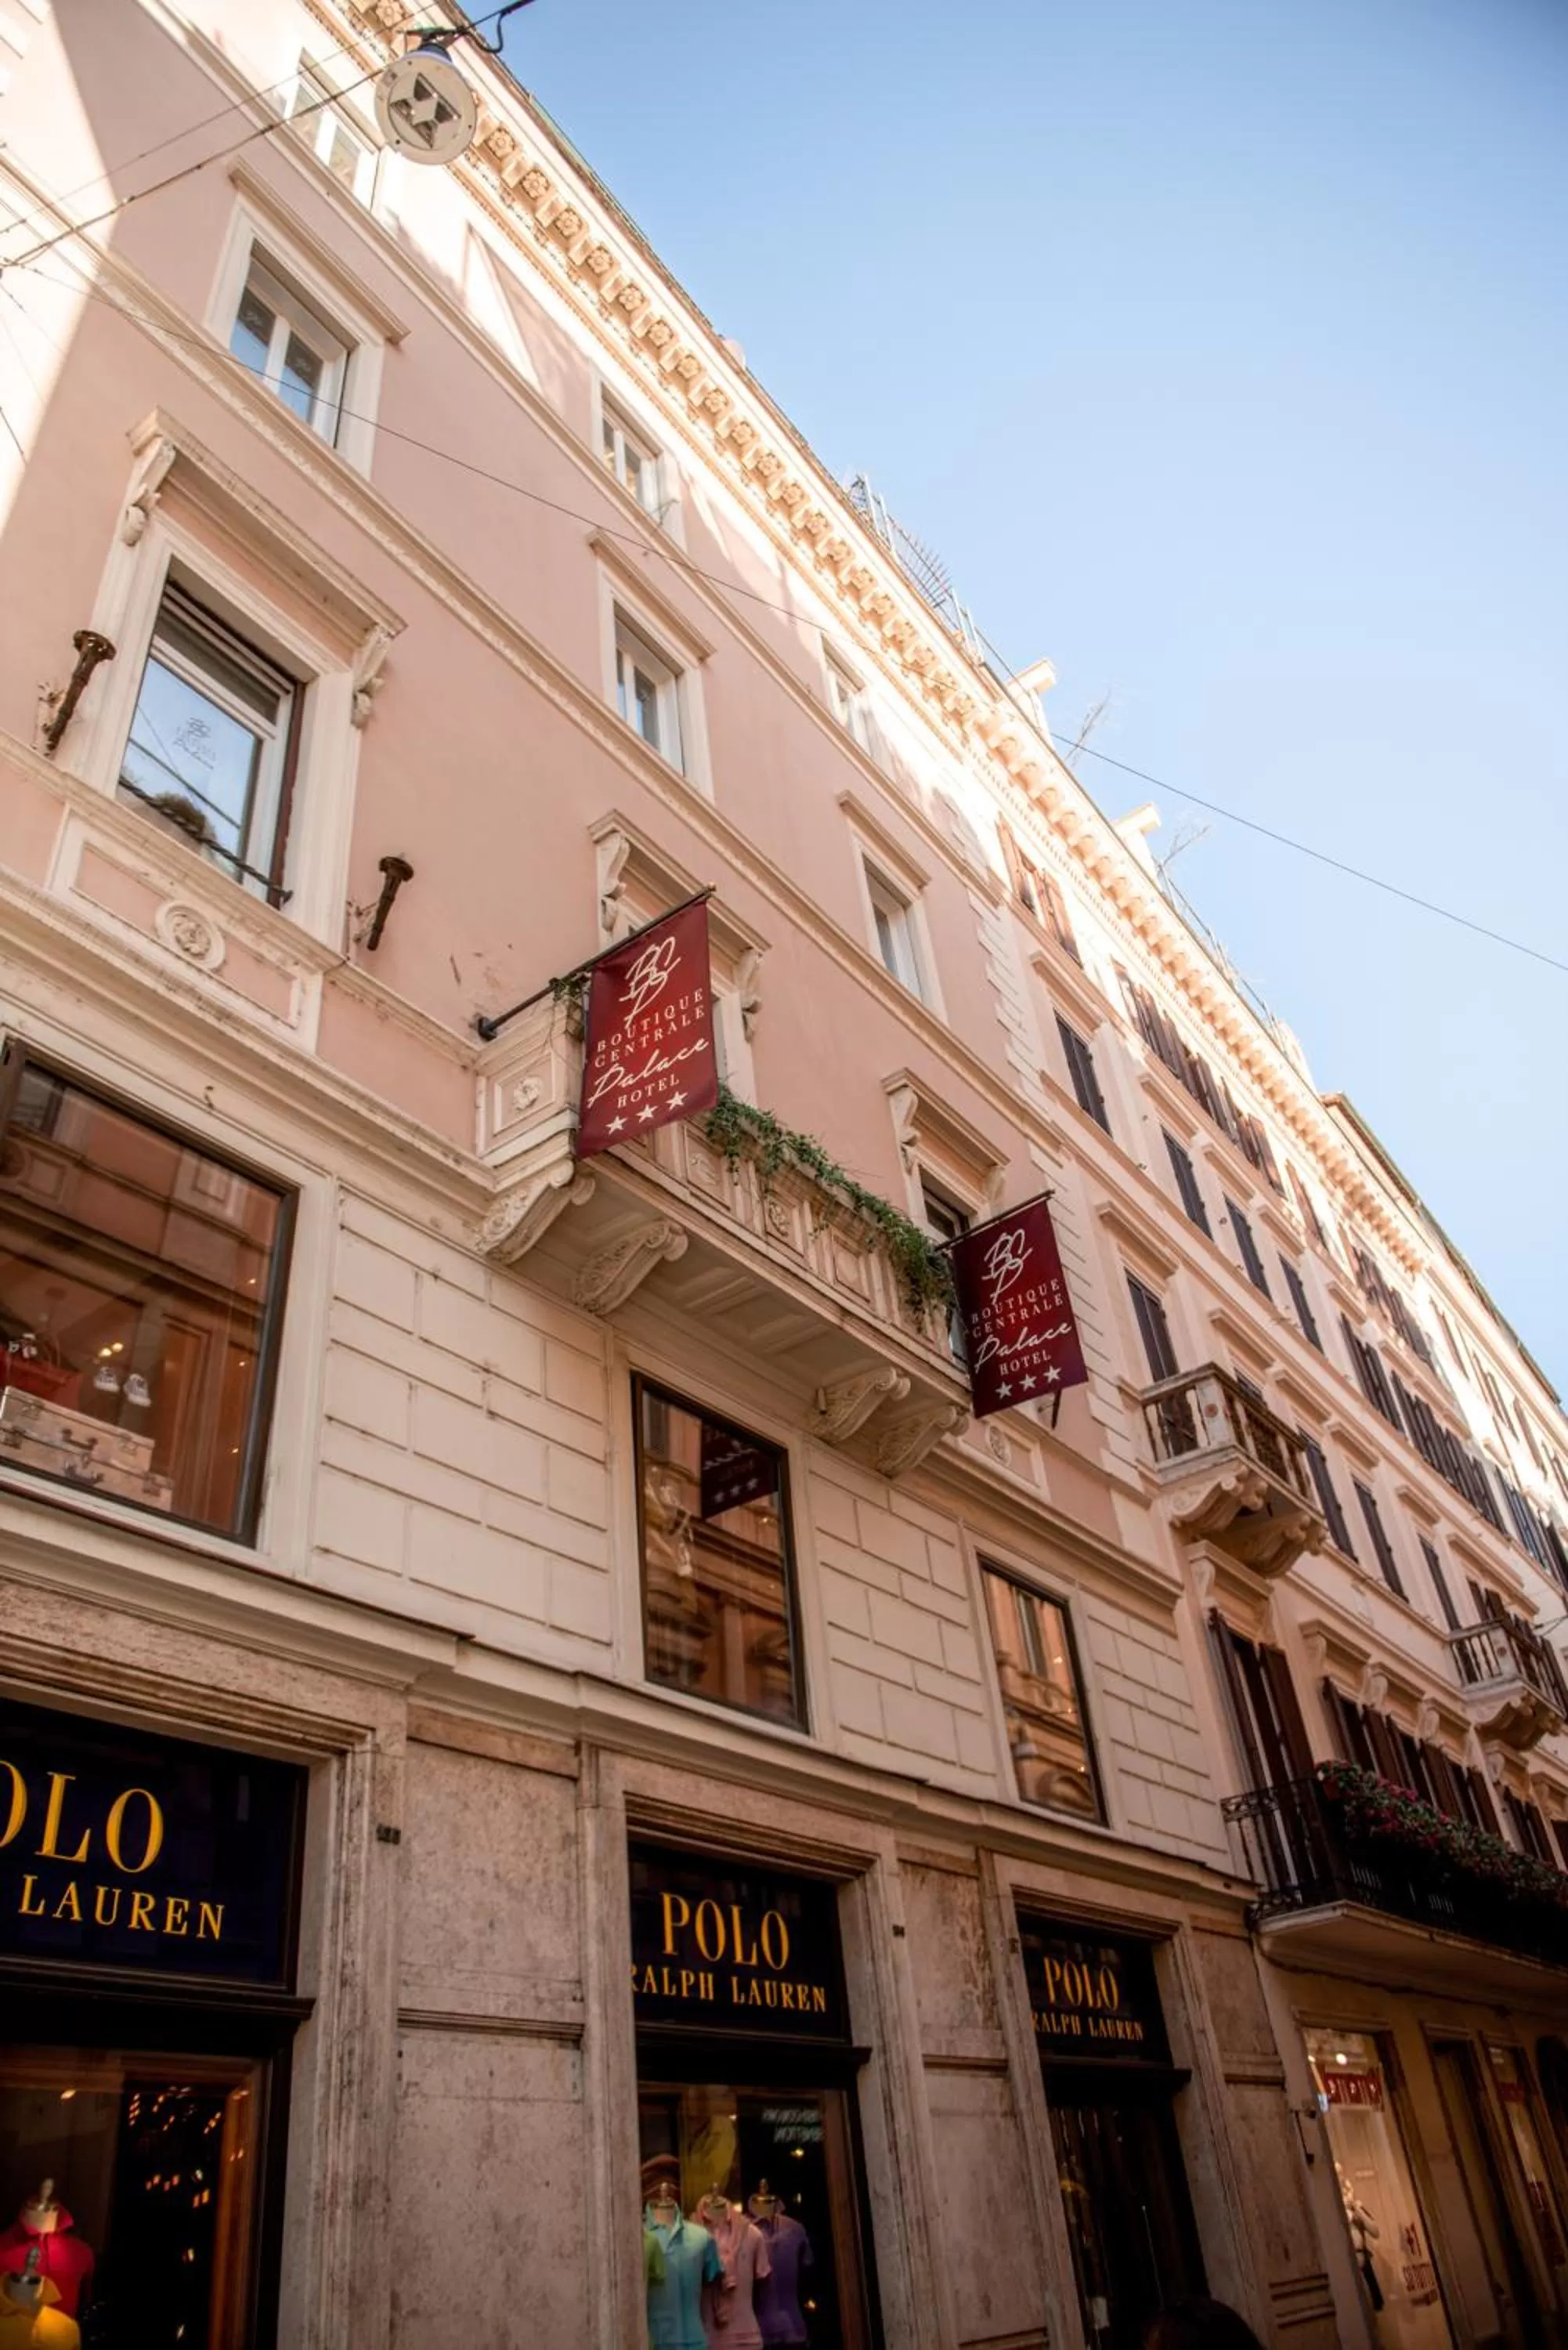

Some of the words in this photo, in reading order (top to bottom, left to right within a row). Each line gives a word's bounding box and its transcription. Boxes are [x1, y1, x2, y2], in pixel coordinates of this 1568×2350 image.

[594, 1004, 706, 1068] CENTRALE
[596, 987, 704, 1054] BOUTIQUE
[587, 1037, 710, 1108] Palace
[616, 1073, 681, 1109] HOTEL
[970, 1278, 1060, 1325] BOUTIQUE
[972, 1293, 1064, 1339] CENTRALE
[974, 1321, 1072, 1374] Palace
[998, 1349, 1052, 1376] HOTEL
[18, 1874, 226, 1941] LAUREN
[659, 1891, 790, 1971] POLO
[730, 1976, 827, 2013] LAUREN
[1043, 1956, 1119, 2010] POLO
[1088, 2016, 1143, 2041] LAUREN
